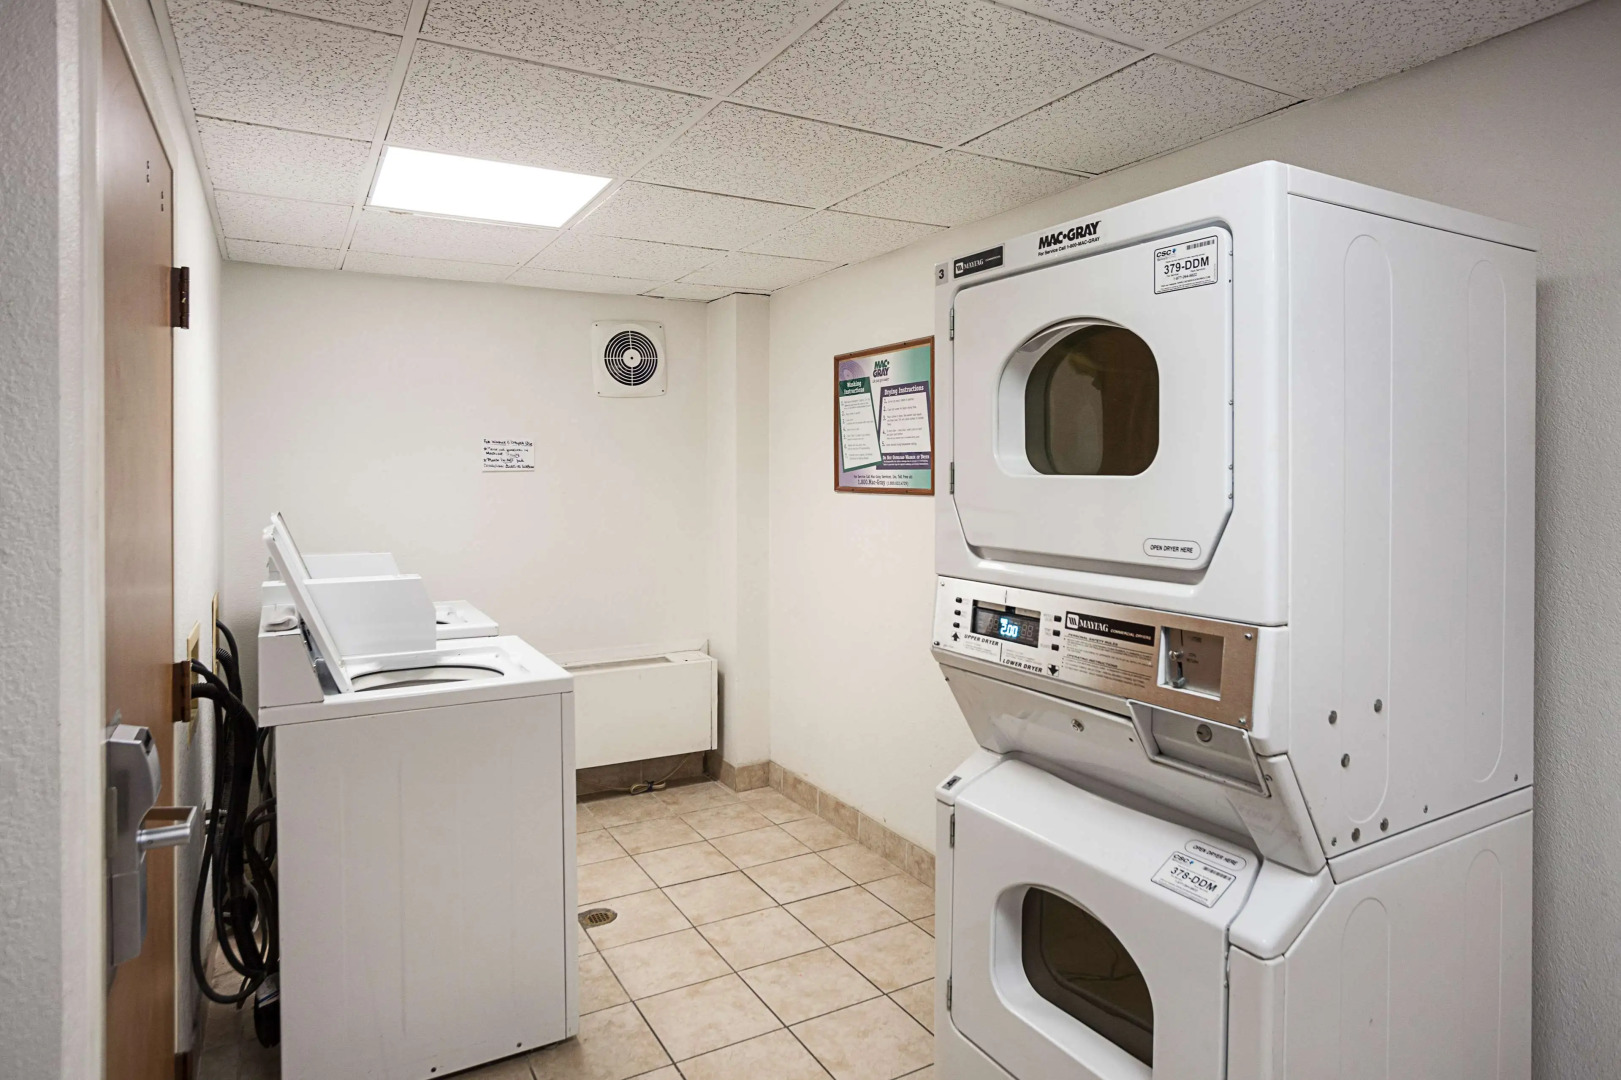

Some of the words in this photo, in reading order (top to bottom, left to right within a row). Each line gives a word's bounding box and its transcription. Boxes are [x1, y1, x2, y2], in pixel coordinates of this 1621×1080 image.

[1156, 249, 1172, 258] CSC
[963, 259, 984, 270] MAYTAG
[1163, 256, 1210, 275] 379-DDM
[938, 268, 945, 280] 3
[872, 367, 890, 378] GRAY
[843, 387, 865, 395] Instructions
[846, 381, 862, 389] Washing
[884, 388, 898, 397] Drying
[898, 385, 925, 394] Instructions
[1079, 619, 1109, 632] MAYTAG
[1110, 628, 1135, 637] COMMERCIAL
[964, 634, 980, 642] UPPER
[981, 637, 999, 646] DRYER
[1003, 658, 1022, 668] LOWER
[1023, 663, 1043, 673] DRYER
[1173, 854, 1189, 864] CSC
[1193, 845, 1206, 853] OPEN
[1206, 851, 1224, 860] DRYER
[1224, 857, 1238, 866] HERE
[1170, 867, 1218, 892] 378-DDM
